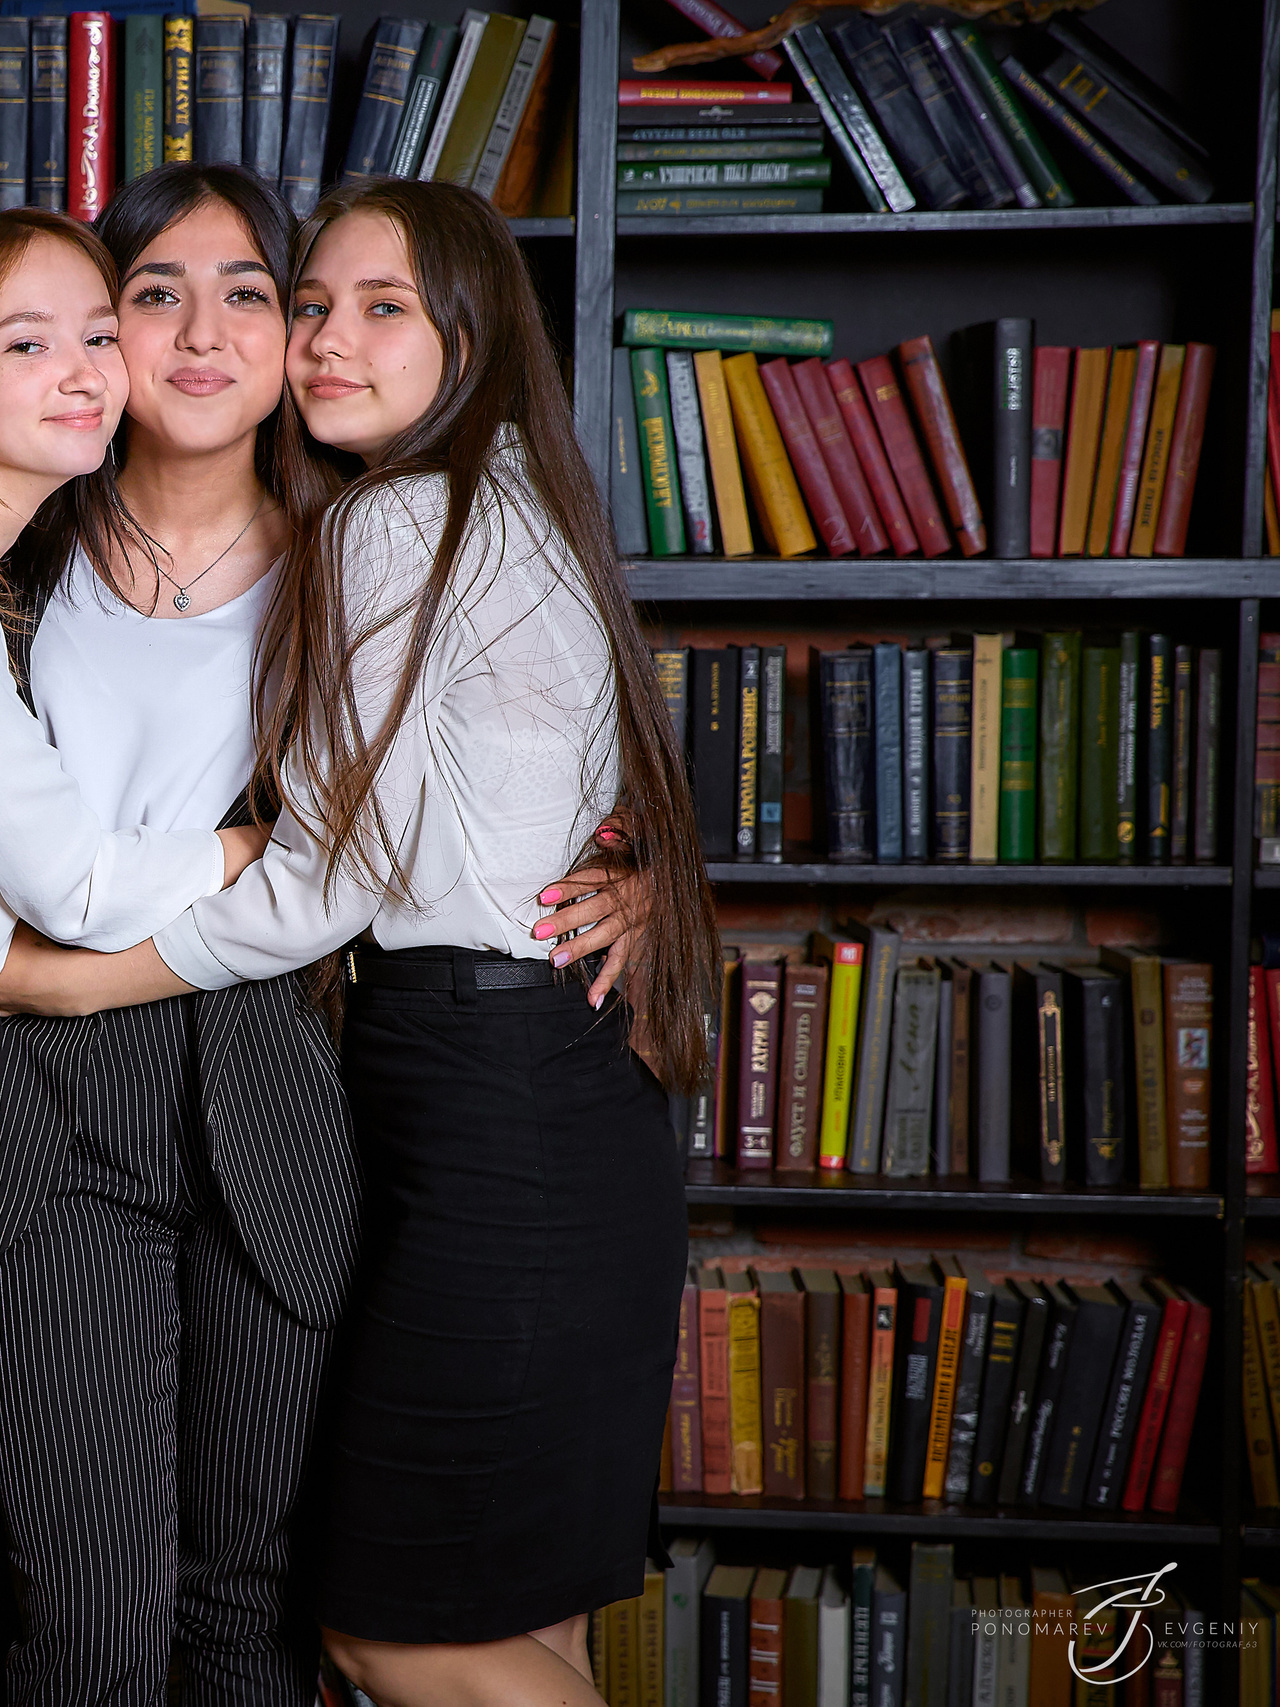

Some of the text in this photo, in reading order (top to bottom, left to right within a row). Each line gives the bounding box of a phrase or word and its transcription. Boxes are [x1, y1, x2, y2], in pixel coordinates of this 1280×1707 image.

[174, 56, 189, 125] ДАУРИЯ
[823, 513, 848, 547] 2
[856, 514, 875, 542] 1
[740, 686, 758, 758] РОББИНС
[751, 1020, 768, 1072] КАТРИН
[787, 1012, 813, 1158] ФАУСТ И СМЕРТЬ
[1109, 1312, 1149, 1437] РОССИЯ МОЛОДАЯ
